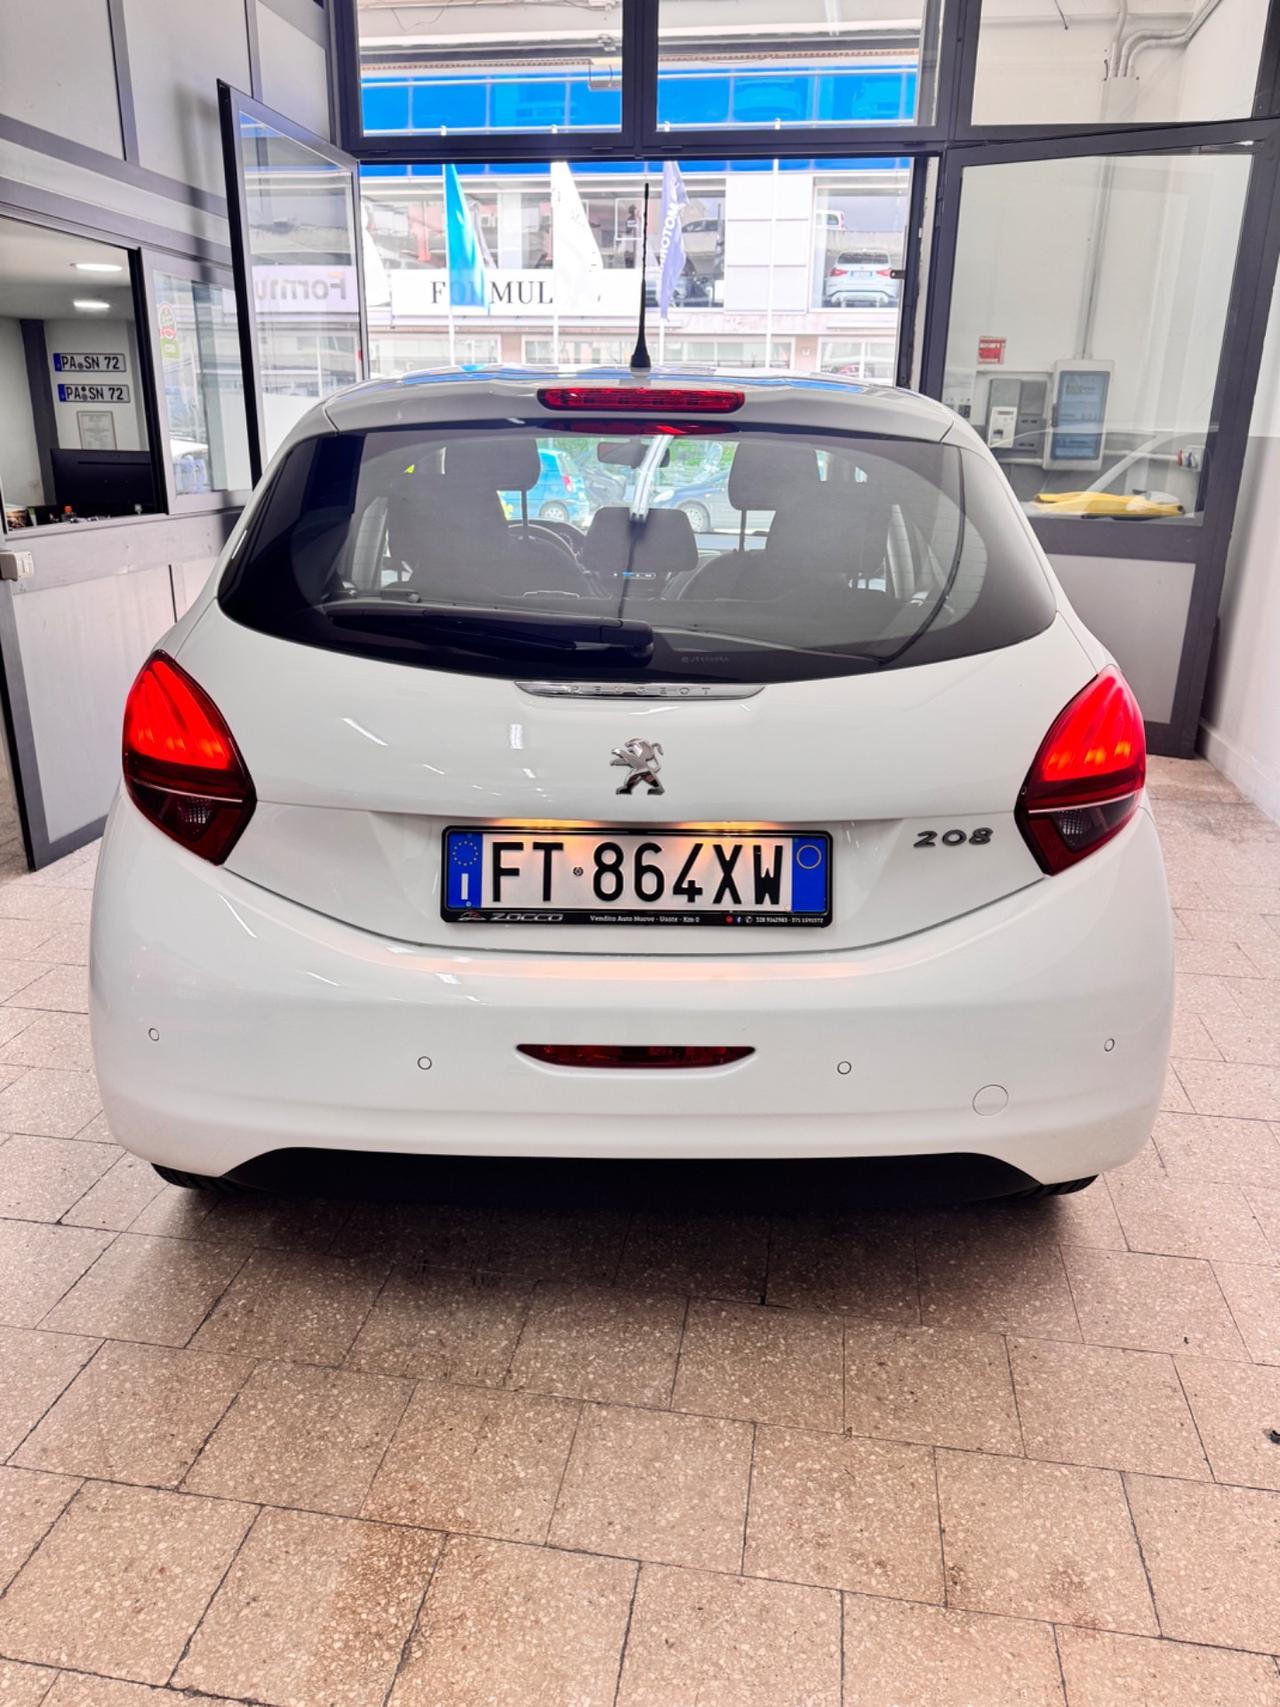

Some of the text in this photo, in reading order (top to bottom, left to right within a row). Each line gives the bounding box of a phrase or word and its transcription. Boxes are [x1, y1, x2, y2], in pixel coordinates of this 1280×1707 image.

[61, 356, 120, 370] PA SN 72
[66, 386, 124, 400] PA SN 72
[913, 827, 993, 848] 208
[492, 841, 783, 905] FT 864XW
[490, 912, 564, 922] ZOCCO
